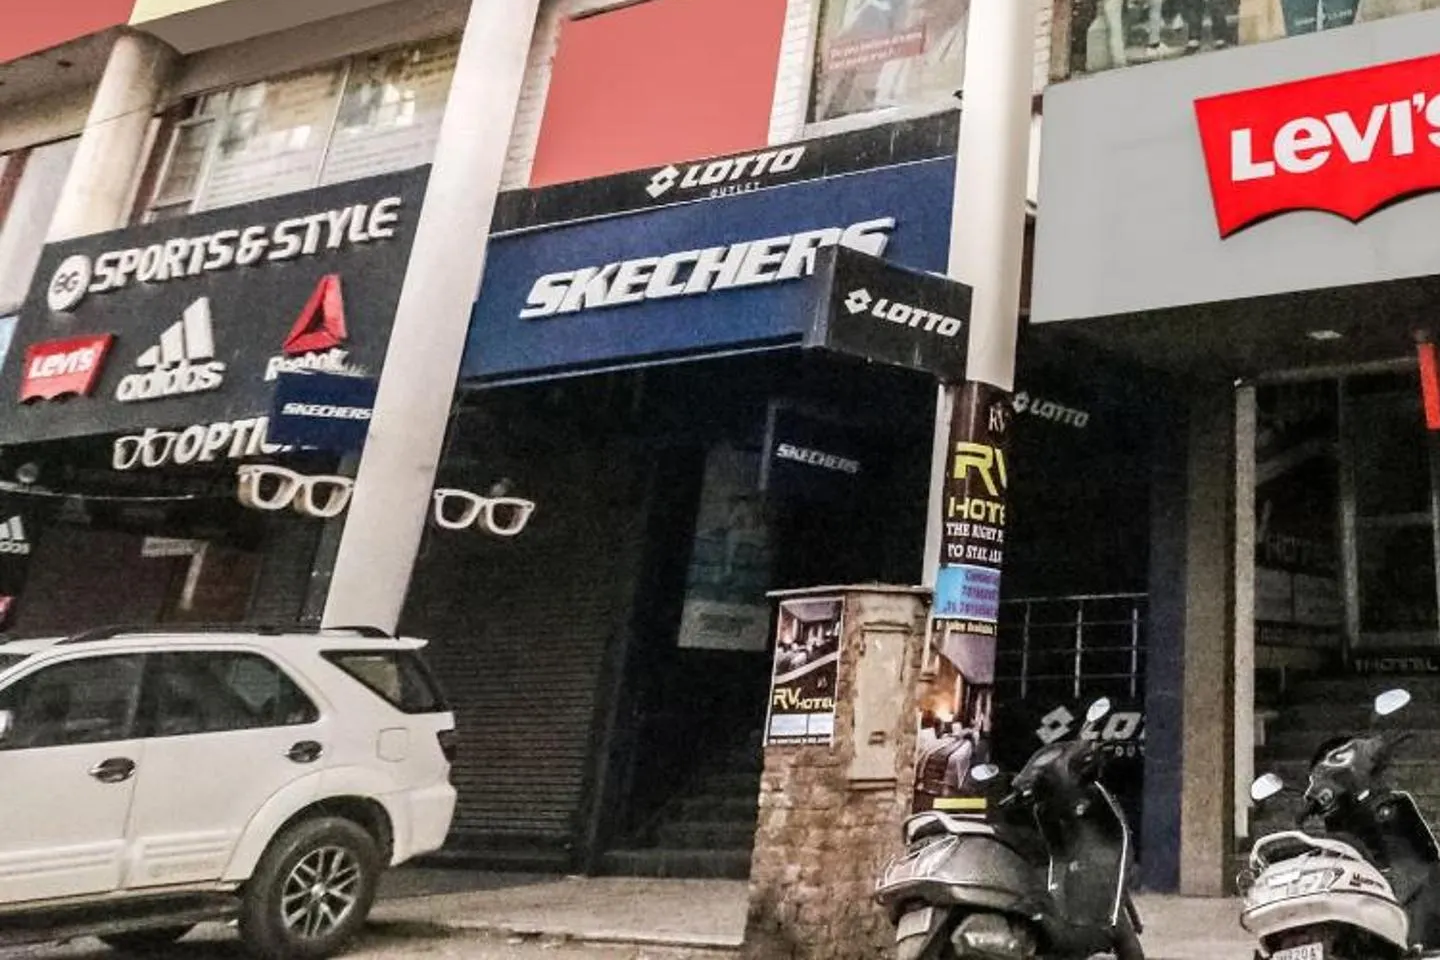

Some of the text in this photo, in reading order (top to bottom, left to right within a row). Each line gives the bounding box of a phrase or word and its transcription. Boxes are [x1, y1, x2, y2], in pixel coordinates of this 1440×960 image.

[680, 146, 806, 189] LOTTO
[518, 216, 896, 320] SKECHERS
[871, 298, 962, 338] LOTTO
[116, 360, 227, 402] adidas
[281, 402, 372, 420] SKECHERS
[1030, 398, 1089, 428] LOTTO
[776, 443, 860, 473] SKECHERS
[946, 522, 970, 537] THE
[947, 543, 964, 558] TO
[773, 687, 801, 709] RV
